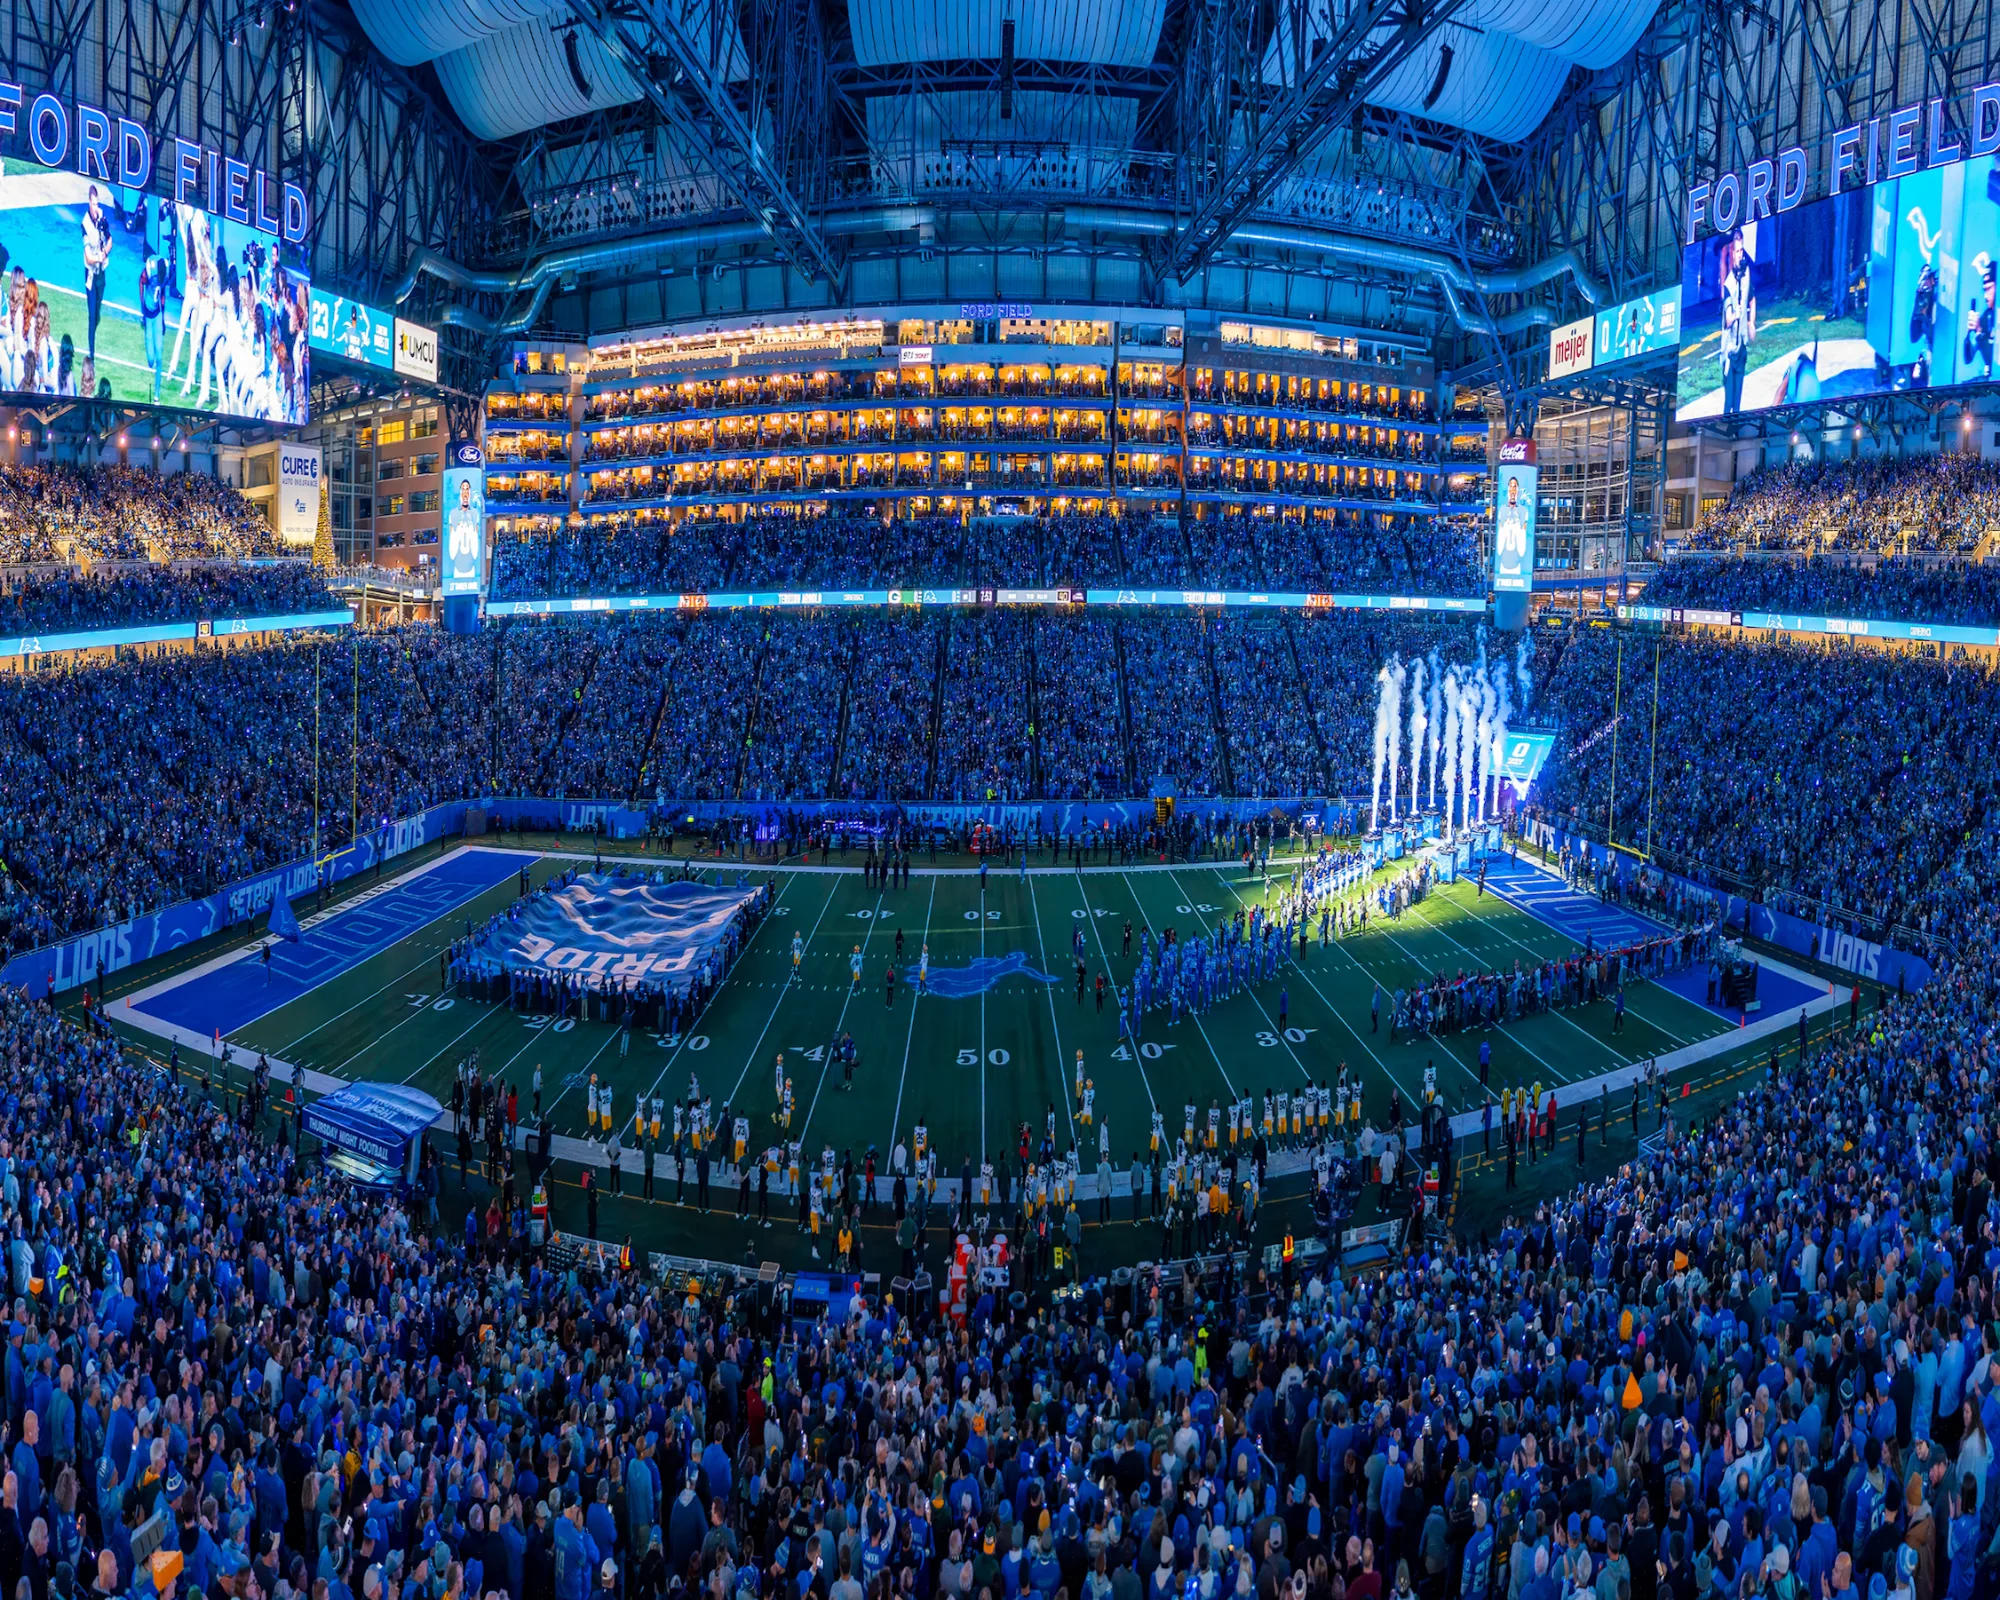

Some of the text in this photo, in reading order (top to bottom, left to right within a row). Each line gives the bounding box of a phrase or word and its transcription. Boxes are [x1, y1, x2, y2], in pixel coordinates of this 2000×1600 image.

[1686, 83, 2000, 245] FORD FIELD
[175, 138, 307, 243] FIELD
[312, 300, 329, 339] 23
[961, 304, 1032, 319] FORD FIELD
[409, 335, 434, 363] UMCU
[1555, 328, 1588, 367] meijer
[1601, 320, 1610, 353] 0
[282, 456, 309, 475] CURE
[462, 448, 479, 460] Ford
[1512, 743, 1531, 757] 0
[385, 813, 426, 859] LIONS
[286, 862, 318, 898] LIONS
[55, 921, 133, 993] LIONS
[508, 932, 699, 976] PRIDE
[1819, 927, 1882, 980] LIONS
[523, 1014, 576, 1032] 20
[1254, 1027, 1307, 1047] 30
[956, 1048, 1011, 1066] 50
[1110, 1042, 1164, 1061] 40
[309, 1116, 389, 1161] THURSDAY NIGHT FOOTBALL
